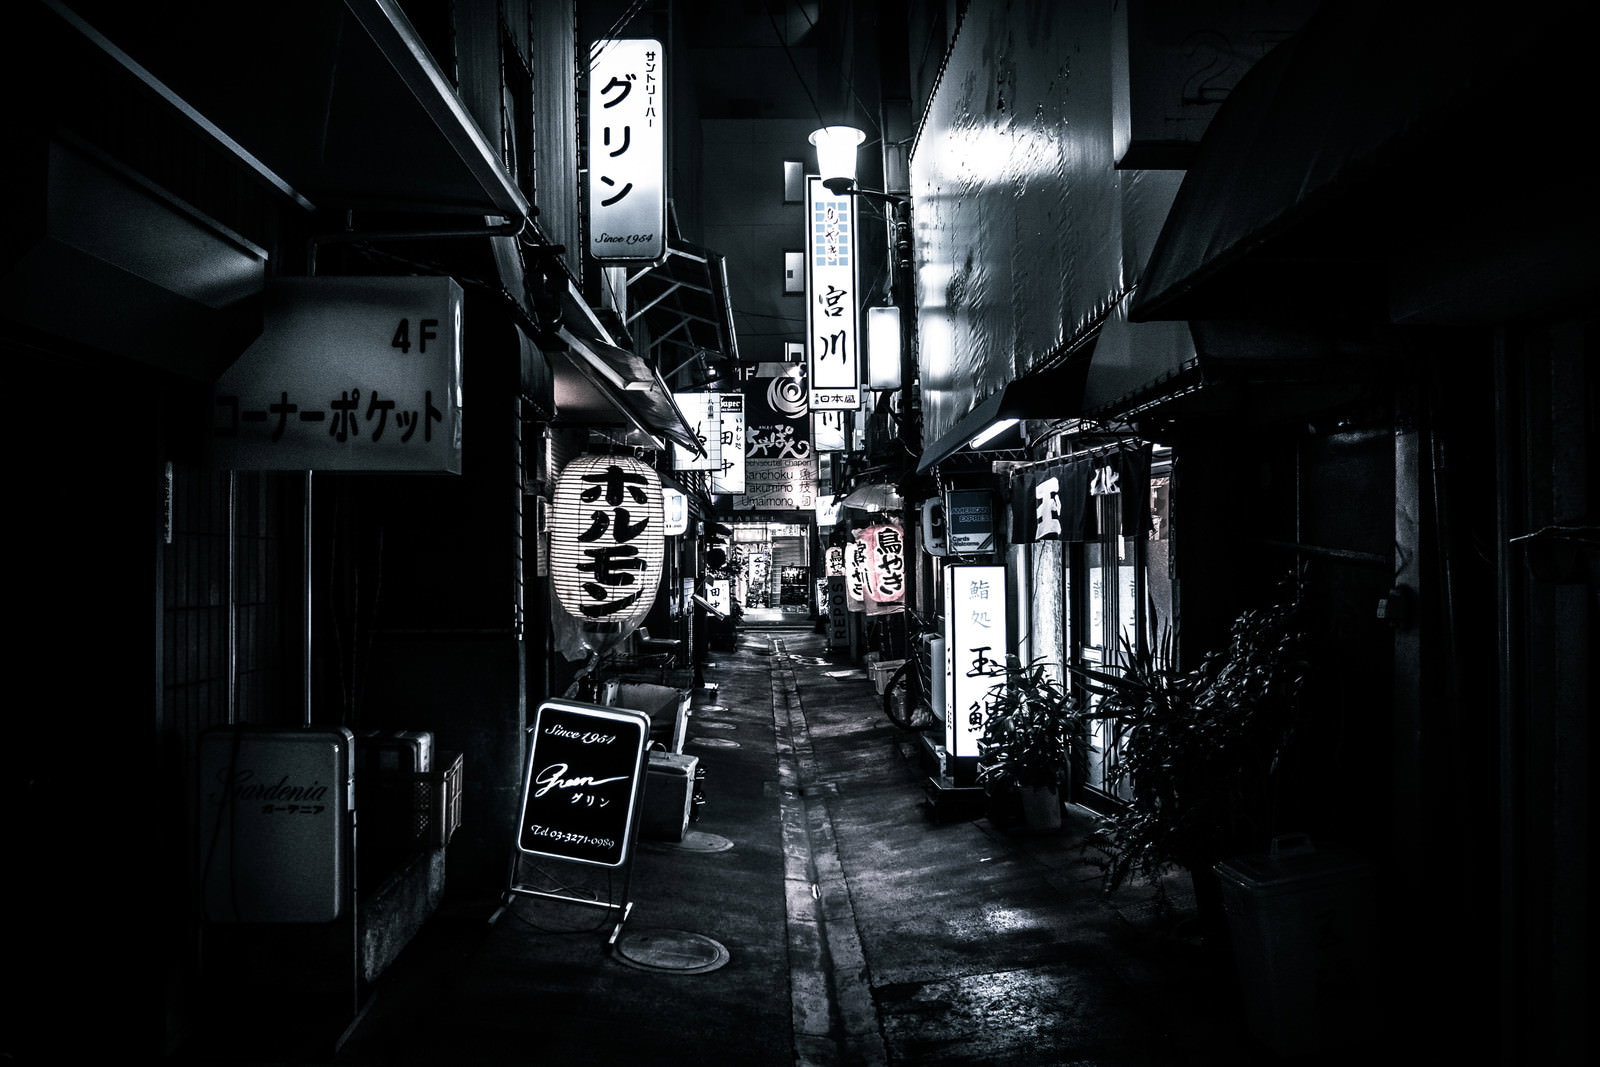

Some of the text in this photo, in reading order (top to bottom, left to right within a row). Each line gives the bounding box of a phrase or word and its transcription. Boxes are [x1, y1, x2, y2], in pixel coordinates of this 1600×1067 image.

[600, 73, 637, 207] グリン
[595, 232, 625, 243] Since
[391, 318, 438, 353] 4F
[819, 285, 847, 365] 宮川
[214, 388, 442, 442] コーナーポケット
[576, 465, 649, 618] ホルモン
[877, 527, 902, 595] 鳥やき
[545, 724, 580, 739] Since
[209, 768, 327, 801] Gardenia
[535, 763, 629, 797] Green
[571, 793, 610, 808] グリン
[550, 830, 615, 850] 03-3271-0989
